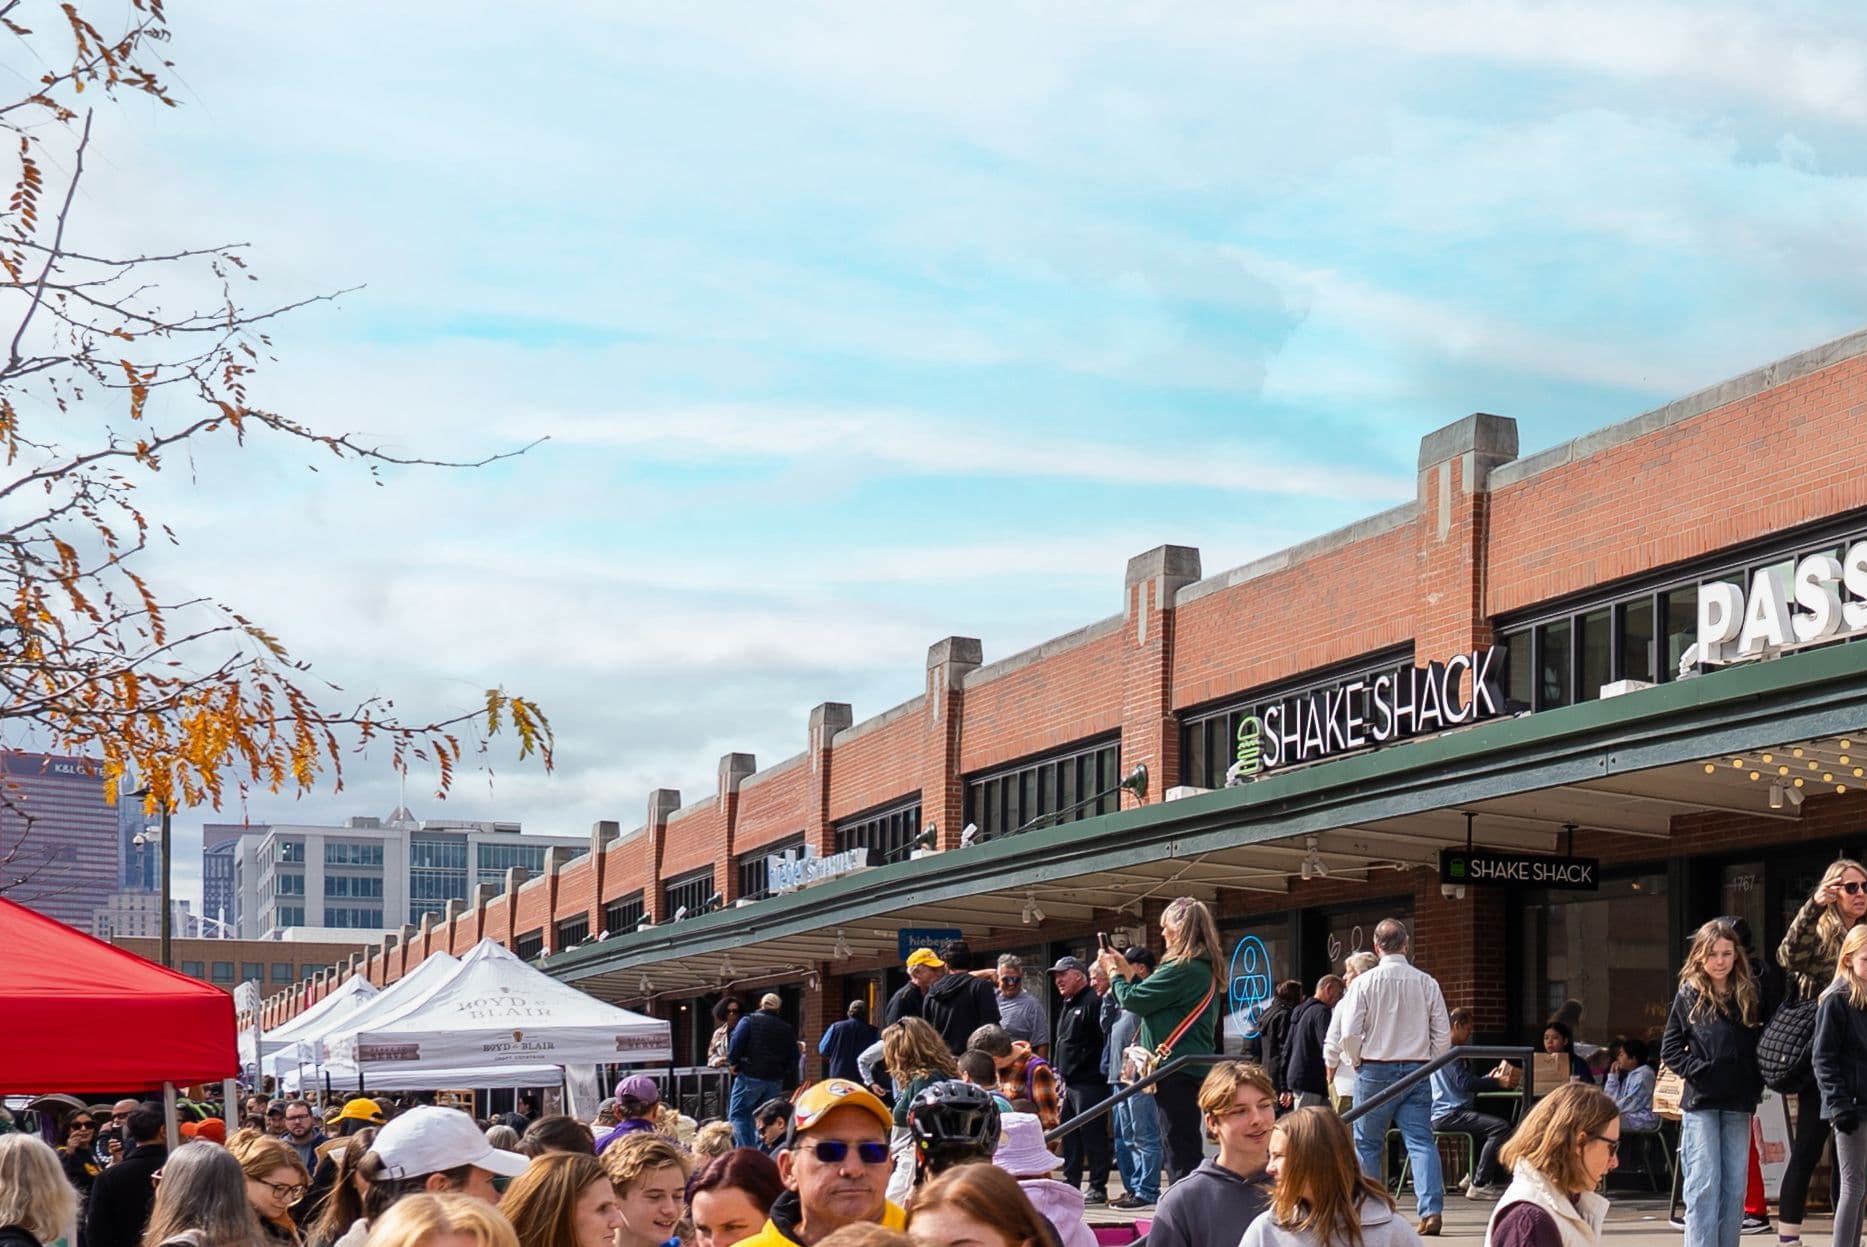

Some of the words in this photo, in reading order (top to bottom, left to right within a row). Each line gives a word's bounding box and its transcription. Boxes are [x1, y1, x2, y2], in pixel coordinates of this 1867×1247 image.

[1263, 682, 1365, 767] SHAKE
[1372, 645, 1496, 741] SHACK
[54, 763, 76, 775] K&L
[76, 765, 106, 777] GTE
[1470, 859, 1529, 880] SHAKE
[1533, 863, 1592, 883] SHACK
[522, 1041, 555, 1050] BLAIR
